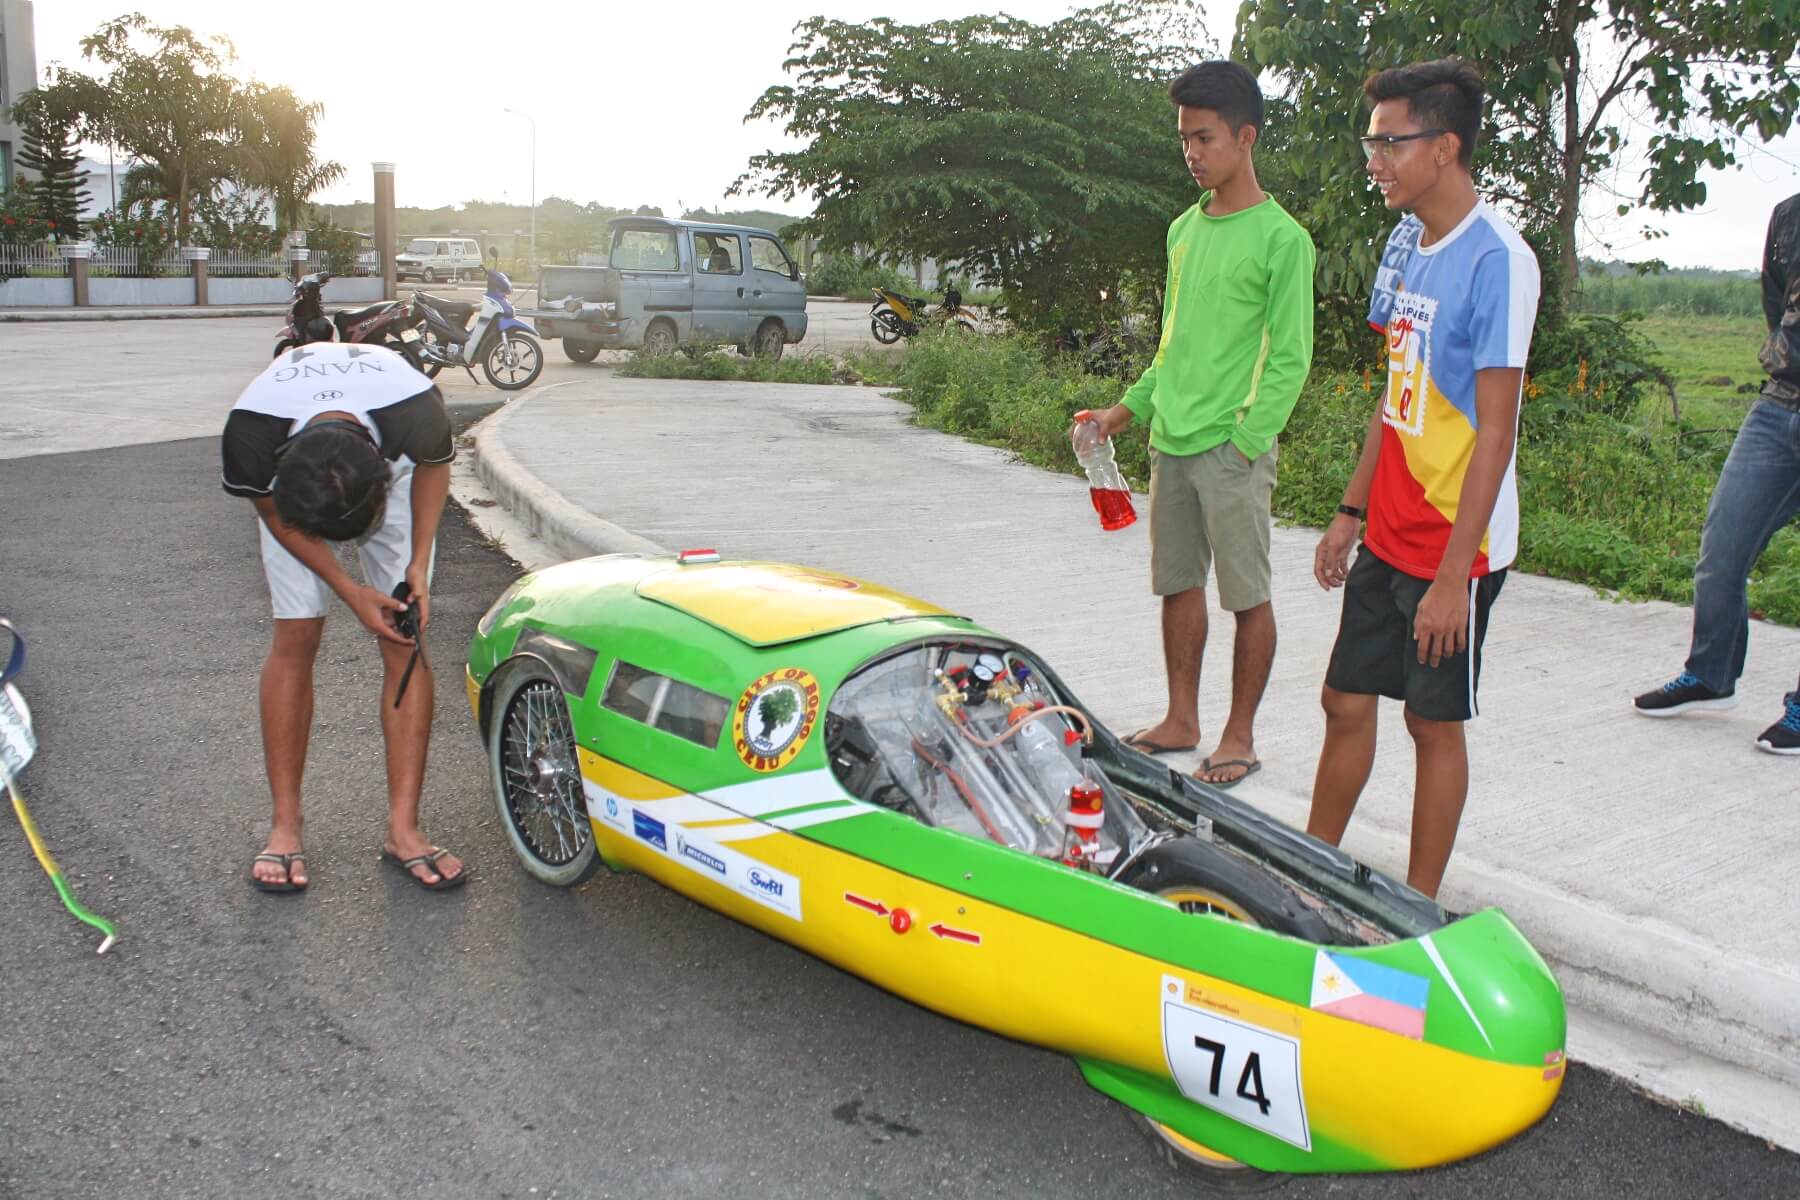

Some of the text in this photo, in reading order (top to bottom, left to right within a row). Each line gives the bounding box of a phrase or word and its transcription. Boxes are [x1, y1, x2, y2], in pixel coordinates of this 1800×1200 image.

[273, 360, 385, 383] NANG
[738, 668, 819, 740] CITY OF BOGO
[737, 738, 779, 770] CEBU
[750, 871, 783, 897] SwRI
[1194, 1035, 1272, 1117] 74
